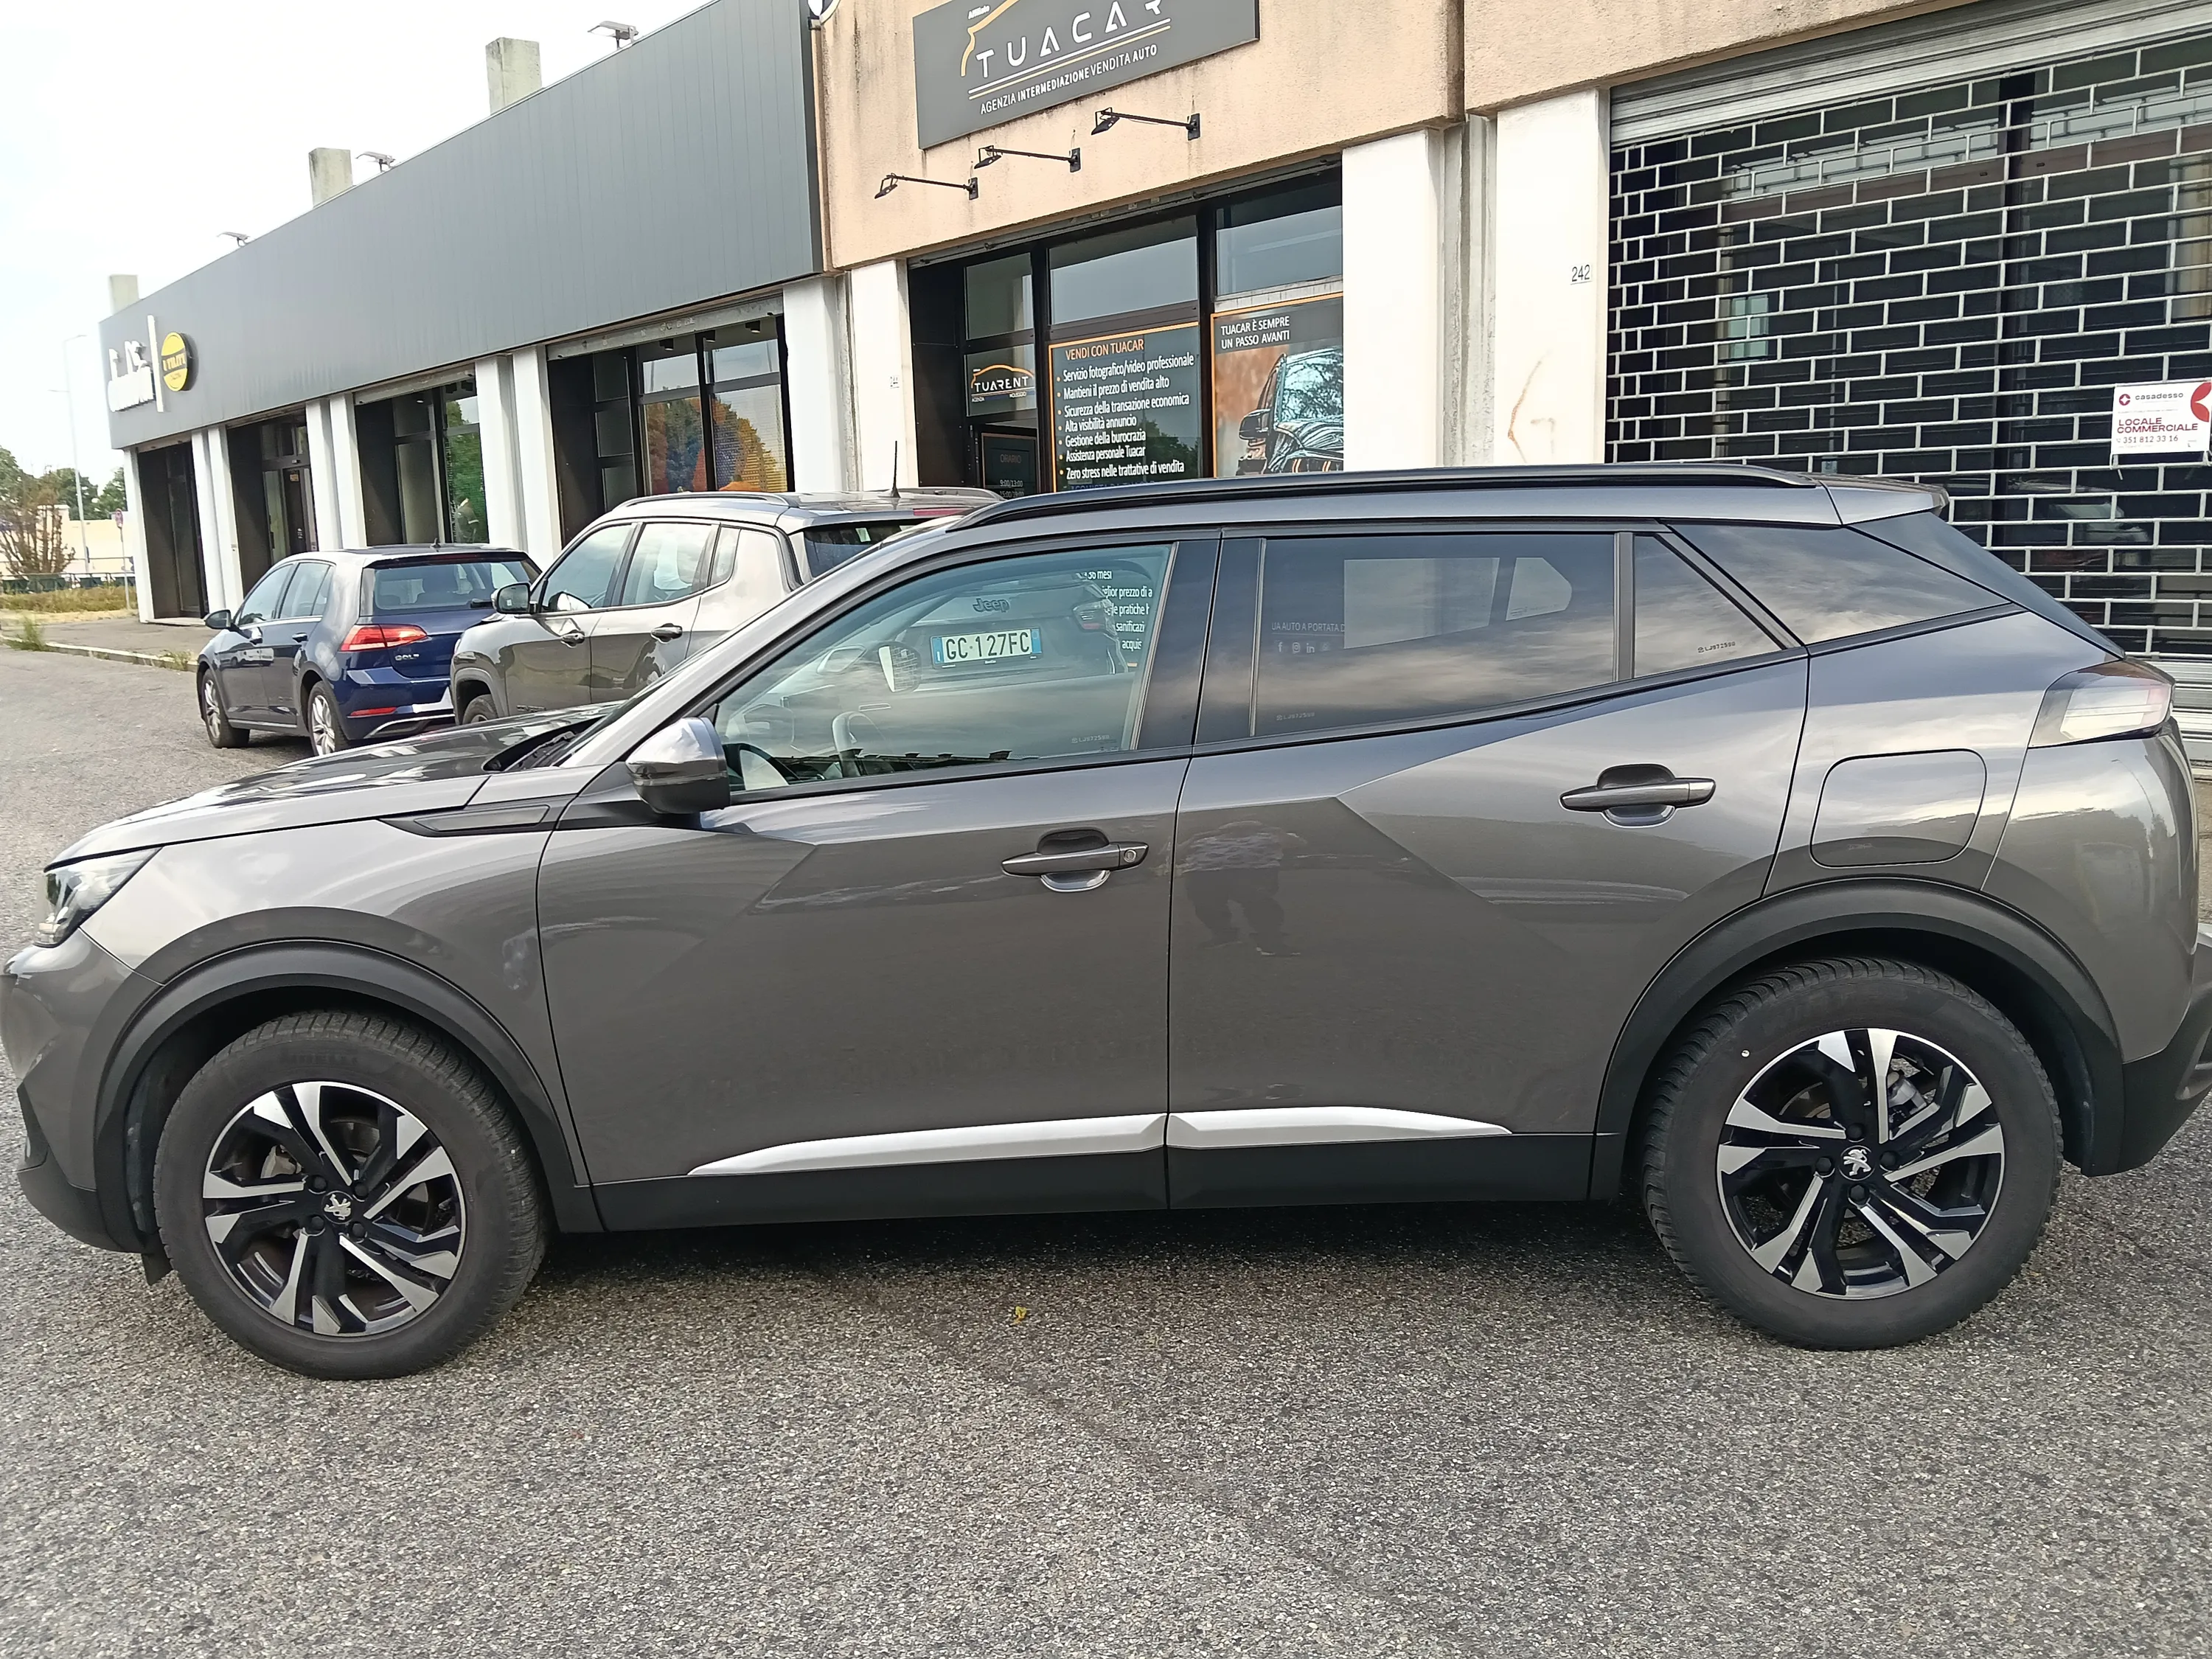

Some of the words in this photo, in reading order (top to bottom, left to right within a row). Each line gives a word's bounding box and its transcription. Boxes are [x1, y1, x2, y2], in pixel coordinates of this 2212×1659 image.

[981, 95, 1017, 115] AGENZIA
[1018, 69, 1090, 102] INTERMEDIAZIONE
[1091, 54, 1131, 76] VENDITA
[1133, 44, 1158, 63] AUTO
[1571, 264, 1590, 282] 242
[1221, 321, 1251, 336] TUACAR
[1252, 319, 1257, 331] È
[1258, 316, 1290, 330] SEMPRE
[1221, 338, 1233, 349] UN
[1235, 335, 1259, 347] PASSO
[1261, 330, 1290, 344] AVANTI
[1065, 349, 1090, 361] VENDI
[1091, 344, 1109, 358] CON
[1110, 338, 1144, 354] TUACAR
[1063, 366, 1088, 382] Servizio
[1088, 358, 1146, 380] fotografico/video
[1147, 352, 1194, 374] professionale
[974, 376, 1029, 392] TUARENT
[1063, 383, 1093, 400] Mantieni
[1093, 383, 1097, 397] il
[1098, 384, 1121, 399] prezzo
[1121, 380, 1128, 393] di
[1128, 375, 1155, 393] vendita
[1155, 375, 1170, 389] alto
[1064, 404, 1093, 418] Sicurezza
[1094, 400, 1110, 414] della
[1111, 397, 1150, 413] transazione
[1151, 392, 1189, 408] economica
[1065, 420, 1078, 433] Alta
[1079, 416, 1105, 431] visibilità
[1105, 414, 1137, 428] annuncio
[2116, 423, 2198, 434] COMMERCIALE
[2118, 417, 2162, 426] LOCALE
[1065, 434, 1093, 448] Gestione
[1093, 432, 1110, 445] della
[1110, 428, 1147, 443] burocrazia
[1065, 449, 1095, 462] Assistenza
[1096, 445, 1124, 463] personale
[1124, 445, 1146, 458] Tuacar
[1066, 467, 1081, 480] Zero
[1082, 466, 1101, 479] stress
[1101, 464, 1118, 478] nelle
[1118, 462, 1150, 476] trattative
[1150, 461, 1157, 474] di
[1158, 459, 1185, 473] vendita
[1119, 588, 1140, 599] prezzo
[1141, 585, 1147, 597] di
[973, 598, 1011, 613] Jeep
[1119, 603, 1145, 616] pratiche
[1116, 620, 1145, 633] sanificazi
[1281, 622, 1301, 631] AUTO
[1301, 622, 1307, 631] A
[1307, 622, 1340, 633] PORTATA
